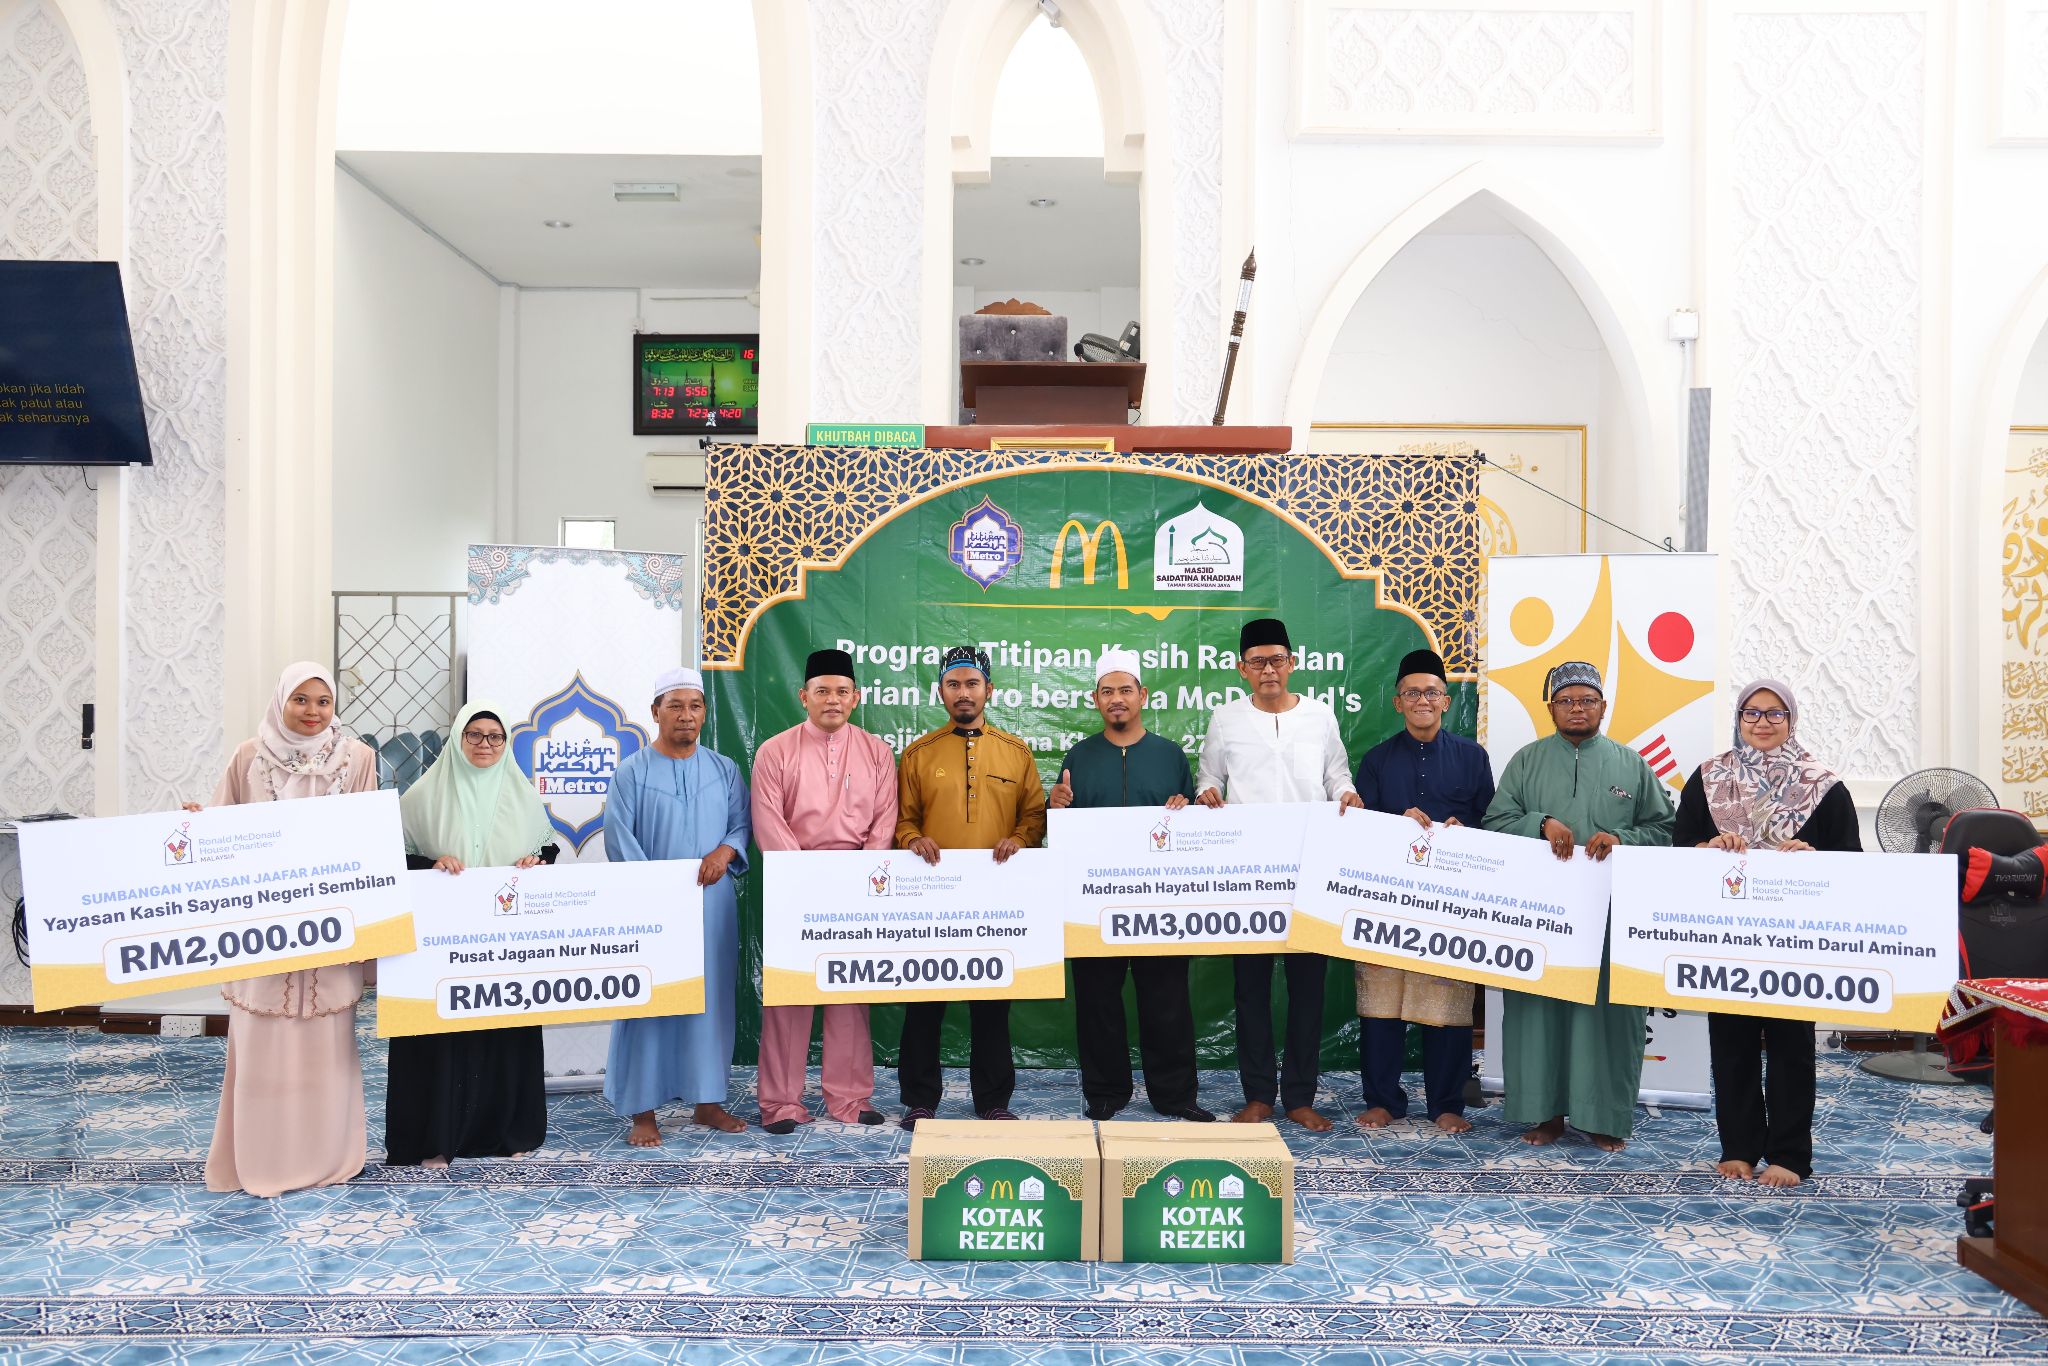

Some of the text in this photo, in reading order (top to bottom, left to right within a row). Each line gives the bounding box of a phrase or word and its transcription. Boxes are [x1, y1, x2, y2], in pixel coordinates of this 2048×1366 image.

[30, 384, 52, 396] jika
[54, 384, 85, 394] lidah
[686, 386, 708, 396] 5:56
[20, 399, 52, 409] patut
[56, 399, 82, 408] atau
[18, 412, 90, 425] seharusnya
[651, 408, 674, 418] 8:32
[720, 408, 742, 418] 4:20
[816, 430, 916, 442] KHUTBAH DIBACA
[970, 552, 1001, 560] Metro
[979, 640, 1092, 673] Titipan
[1199, 645, 1344, 670] Radan
[860, 679, 920, 705] rian
[1032, 683, 1168, 710] bersa
[544, 778, 607, 793] Metro
[198, 829, 281, 846] Ronald McDonald
[1176, 829, 1242, 839] Ronald McDonald
[1176, 838, 1200, 847] House
[199, 846, 230, 854] House
[200, 854, 235, 862] MALAYSIA
[1436, 848, 1505, 867] Ronald McDonald
[1435, 856, 1459, 866] House
[895, 874, 962, 884] Ronald McDonald
[1087, 864, 1300, 878] SUMBANGAN YAYASAN JAAFAR AHMA
[81, 861, 361, 906] SUMBANGAN YAYASAN JAAFAR AHMAD
[895, 882, 920, 891] House
[1082, 879, 1295, 896] Madrasah Hayatul Islam Remb
[1339, 867, 1566, 916] SUMBANGAN YAYASAN JAAFAR AHMAD
[1752, 877, 1830, 889] Ronald McDonald
[1752, 886, 1780, 895] House
[524, 890, 596, 900] Ronald McDonald
[43, 876, 395, 932] Yayasan Kasih Sayang Negeri Sembilan
[524, 900, 550, 908] House
[1327, 881, 1573, 935] Madrasah Dinul Hayah Kuala Pilah
[803, 910, 1025, 923] SUMBANGAN YAYASAN JAAFAR AHMAD
[1652, 912, 1908, 935] SUMBANGAN YAYASAN JAAFAR AHMAD
[801, 925, 1027, 942] Madrasah Hayatul Islam Chenor
[1112, 911, 1286, 940] RM3,000.00
[423, 924, 663, 947] SUMBANGAN YAYASAN JAAFAR AHMAD
[1628, 927, 1936, 957] Pertubuhan Anak Yatim Darul Aminan
[120, 916, 342, 974] RM2,000.00
[449, 940, 639, 963] Pusat Jagaan Nur Nusari
[1353, 918, 1534, 972] RM2,000.00
[828, 957, 1004, 986] RM2,000.00
[450, 974, 640, 1010] RM3,000.00
[1677, 964, 1879, 1004] RM2,000.00
[962, 1208, 1044, 1227] KOTAK
[1162, 1206, 1244, 1226] KOTAK
[960, 1230, 1044, 1250] REZEKI
[1160, 1230, 1244, 1248] REZEKI
